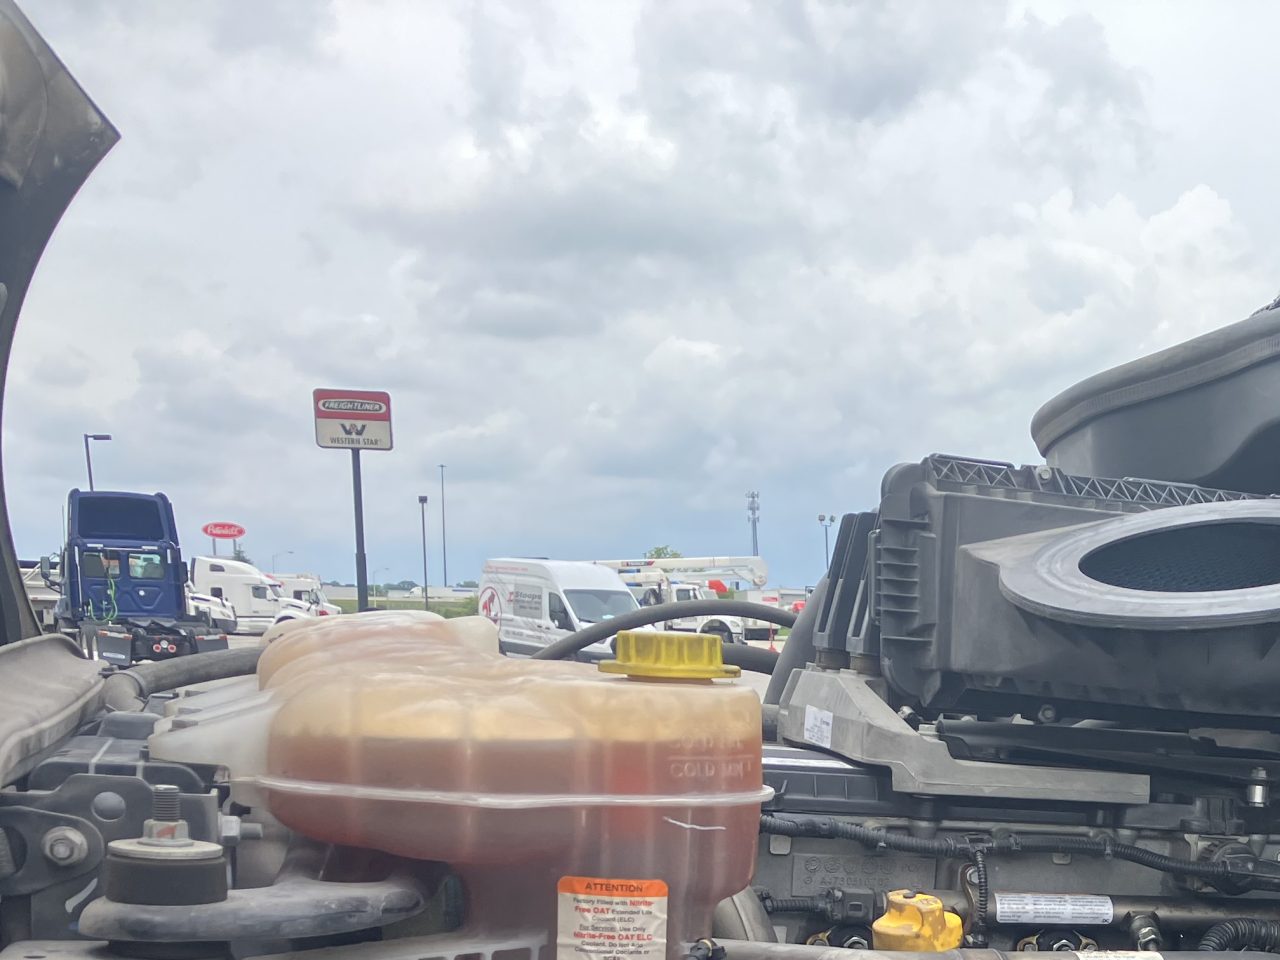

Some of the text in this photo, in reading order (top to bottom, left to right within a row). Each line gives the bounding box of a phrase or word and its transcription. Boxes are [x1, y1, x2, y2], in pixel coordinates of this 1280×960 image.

[324, 400, 380, 411] FREIGHTLINER
[329, 437, 380, 446] WESTERN STAR
[585, 882, 643, 893] ATTENTION
[574, 932, 616, 940] Nitrite-Free
